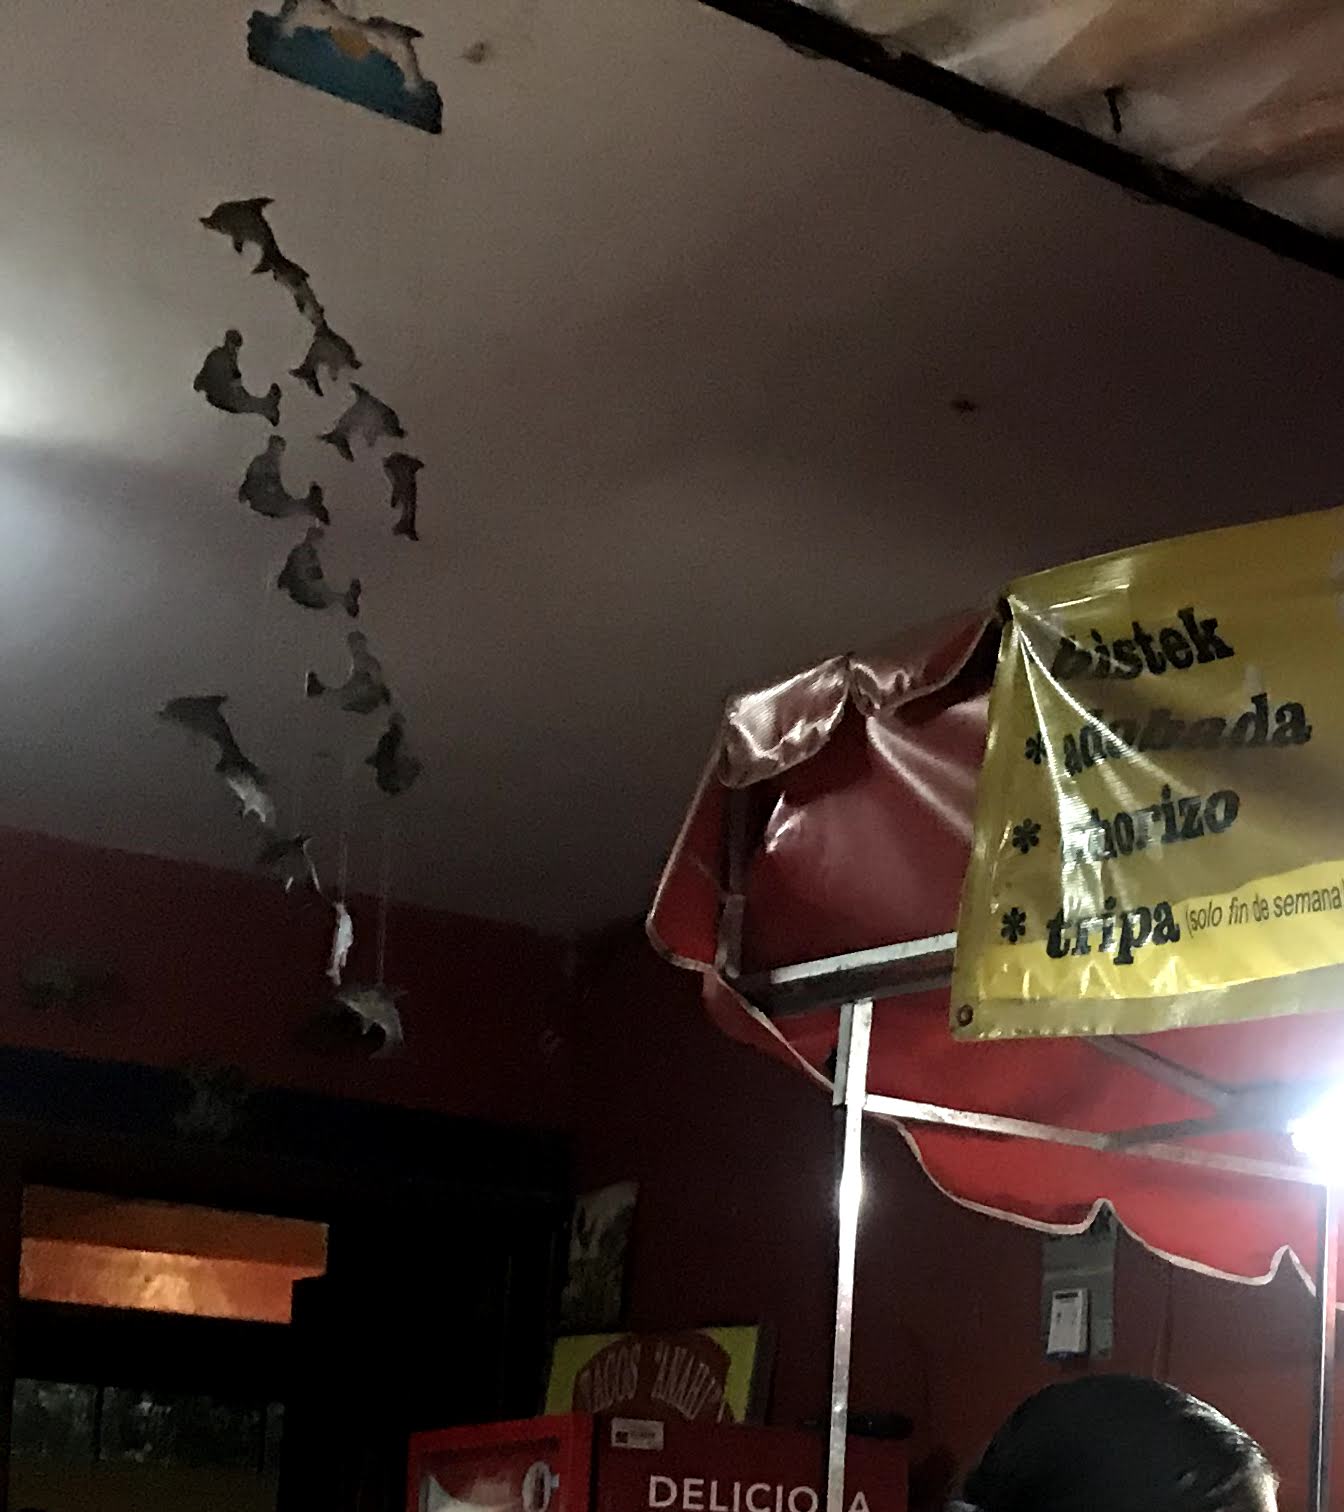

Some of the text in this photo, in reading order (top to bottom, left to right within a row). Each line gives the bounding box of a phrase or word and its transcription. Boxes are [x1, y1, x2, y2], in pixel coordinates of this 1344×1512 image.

[1045, 895, 1181, 967] tripa
[1185, 898, 1223, 941] (solo
[1228, 896, 1250, 926] fin
[1252, 897, 1271, 923] de
